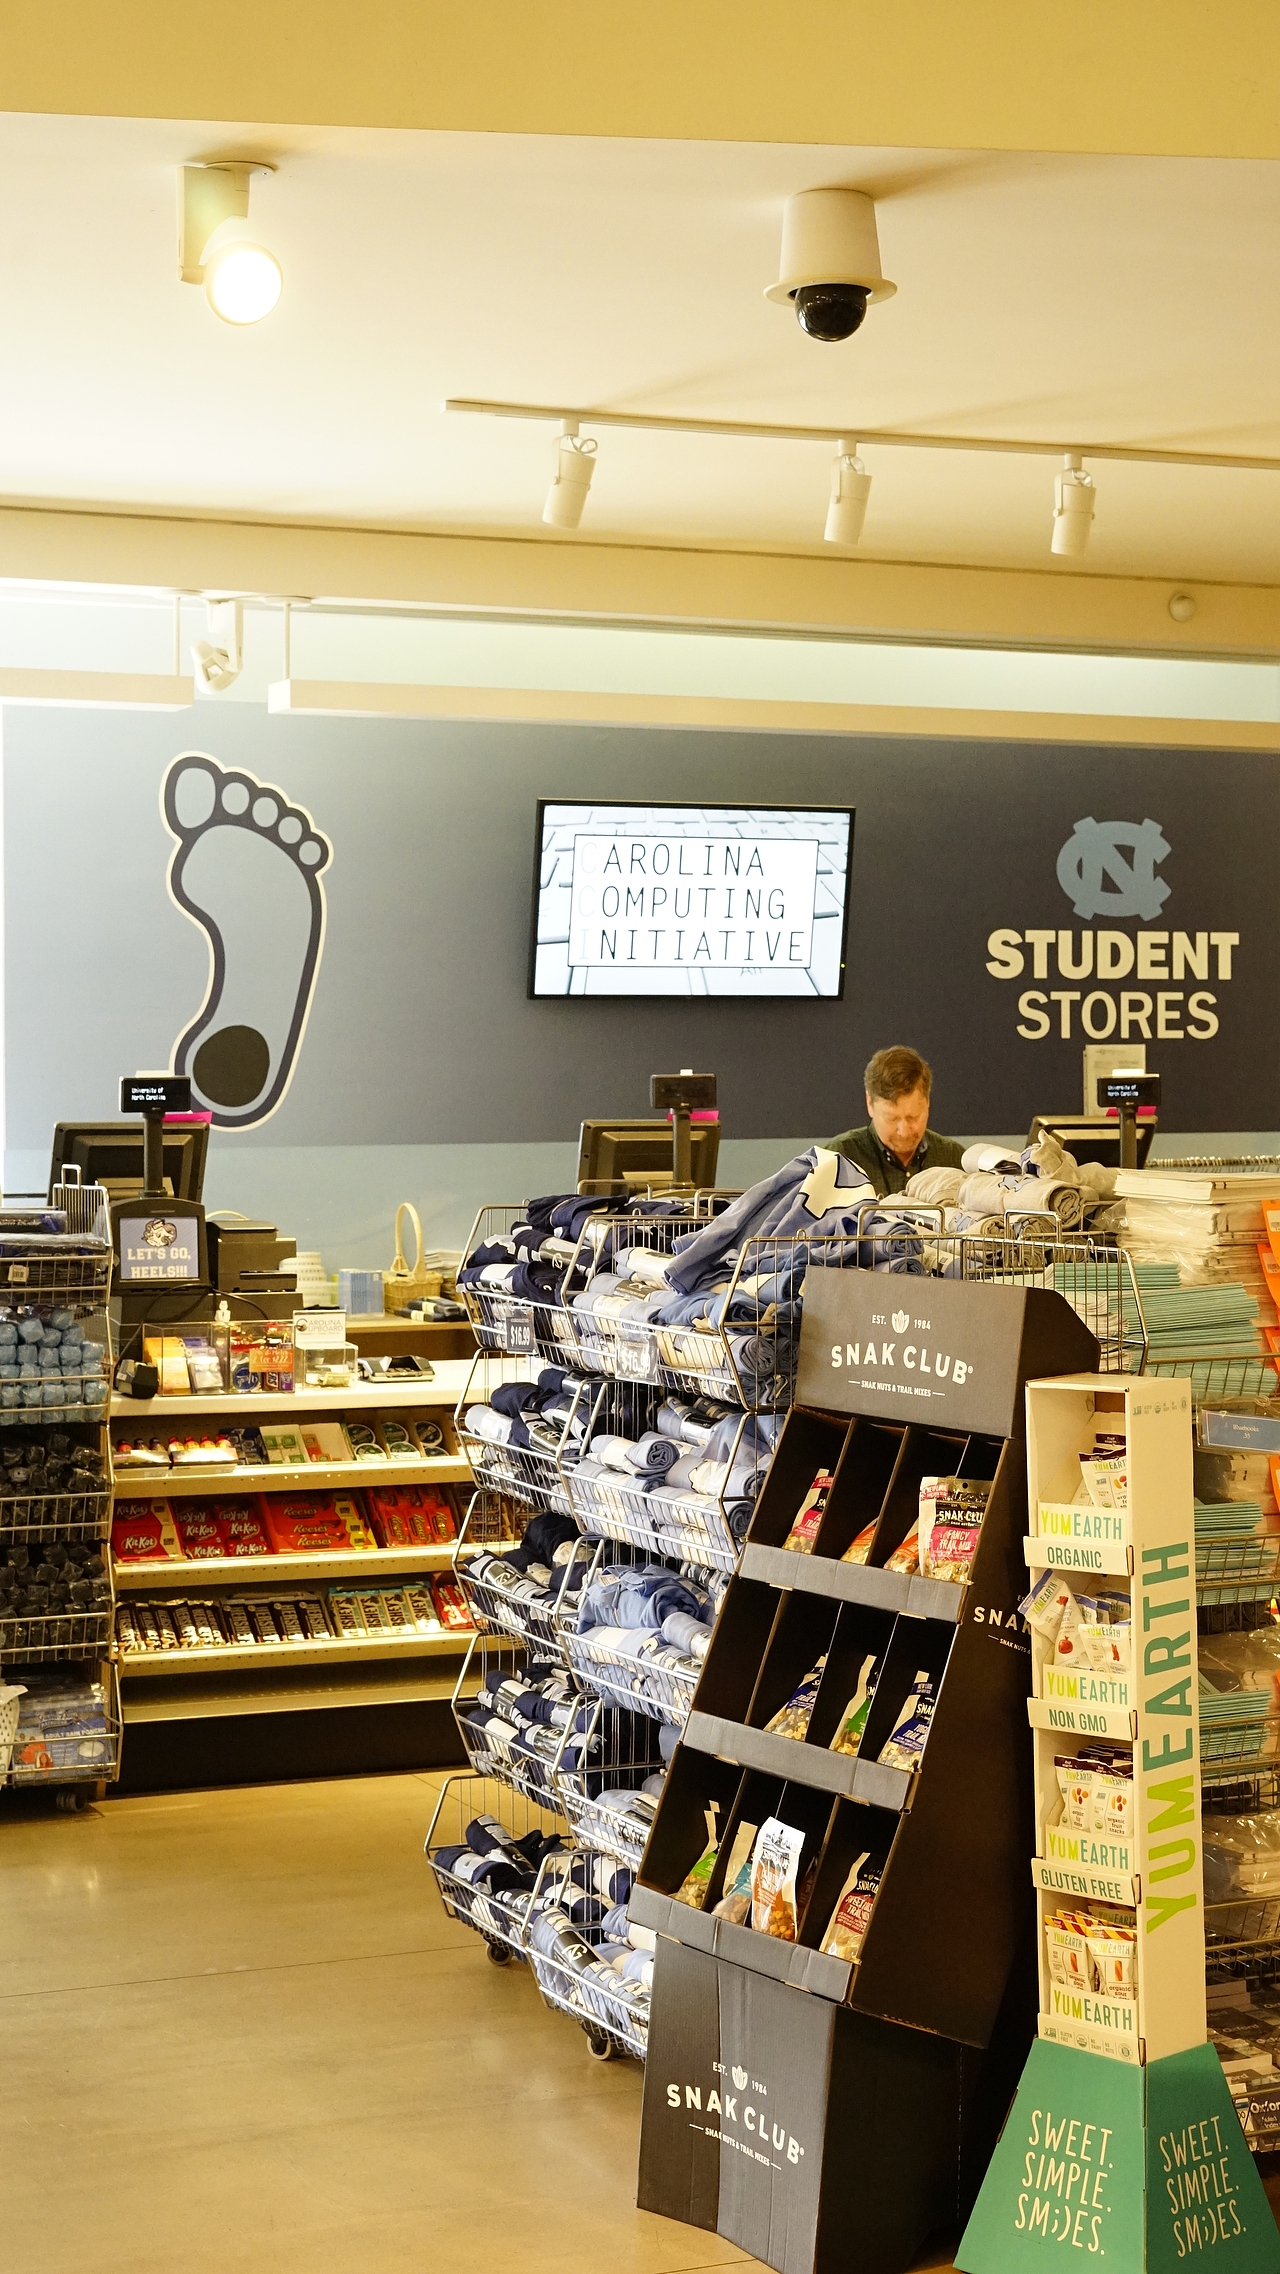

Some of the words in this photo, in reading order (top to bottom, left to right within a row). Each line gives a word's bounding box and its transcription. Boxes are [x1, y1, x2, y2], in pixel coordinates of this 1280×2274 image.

[985, 928, 1240, 980] STUDENT
[1016, 990, 1219, 1040] STORES
[127, 1247, 166, 1260] LET'S
[170, 1247, 192, 1260] GO,
[131, 1265, 188, 1279] HEELS!!!
[872, 1314, 887, 1325] EST.
[914, 1319, 931, 1330] 1984
[510, 1325, 531, 1346] $16.99
[831, 1342, 896, 1368] SNAK
[861, 1380, 877, 1389] SNAK
[877, 1382, 892, 1391] NUTS
[891, 1384, 896, 1392] &
[897, 1385, 913, 1395] TRAIL
[914, 1387, 932, 1397] MIXES
[1093, 1460, 1126, 1470] YUMEART
[939, 1510, 964, 1521] SNAK
[966, 1510, 984, 1524] CLU
[1041, 1510, 1123, 1541] YUMEARTH
[947, 1530, 970, 1540] FANCY
[1047, 1546, 1103, 1569] ORGANIC
[1031, 1582, 1058, 1615] YUMEARTH
[1086, 1627, 1121, 1638] YUMEARTH
[999, 1638, 1014, 1648] SNAK
[1014, 1643, 1027, 1653] NUTS
[1047, 1672, 1128, 1705] YUMEARTH
[1049, 1709, 1076, 1729] NON
[1079, 1711, 1108, 1733] GMO
[1141, 1541, 1198, 1935] YUMEARTH
[1049, 1833, 1129, 1870] YUMEARTH
[1041, 1868, 1088, 1894] GLUTEN
[1091, 1880, 1123, 1900] FREE
[1099, 1912, 1134, 1925] YUMEART
[1053, 1932, 1083, 1949] YUMEARTH
[1094, 1942, 1130, 1955] YUMEARTH
[1069, 1974, 1086, 1983] organic
[1054, 1989, 1133, 2031] YUMEARTH
[712, 2061, 728, 2076] EST.
[751, 2080, 768, 2096] 1984
[667, 2083, 738, 2122] SNAK
[1250, 2101, 1280, 2114] Oxfor
[705, 2127, 723, 2140] SNAK
[722, 2133, 736, 2148] NUTS
[735, 2141, 740, 2150] &
[740, 2143, 755, 2158] TRAIL
[754, 2151, 770, 2167] MIXES
[1028, 2110, 1113, 2169] SWEET.
[1159, 2115, 1229, 2173] SWEET.
[1022, 2151, 1112, 2213] SIMPLE.
[1166, 2157, 1240, 2215] SIMPLE.
